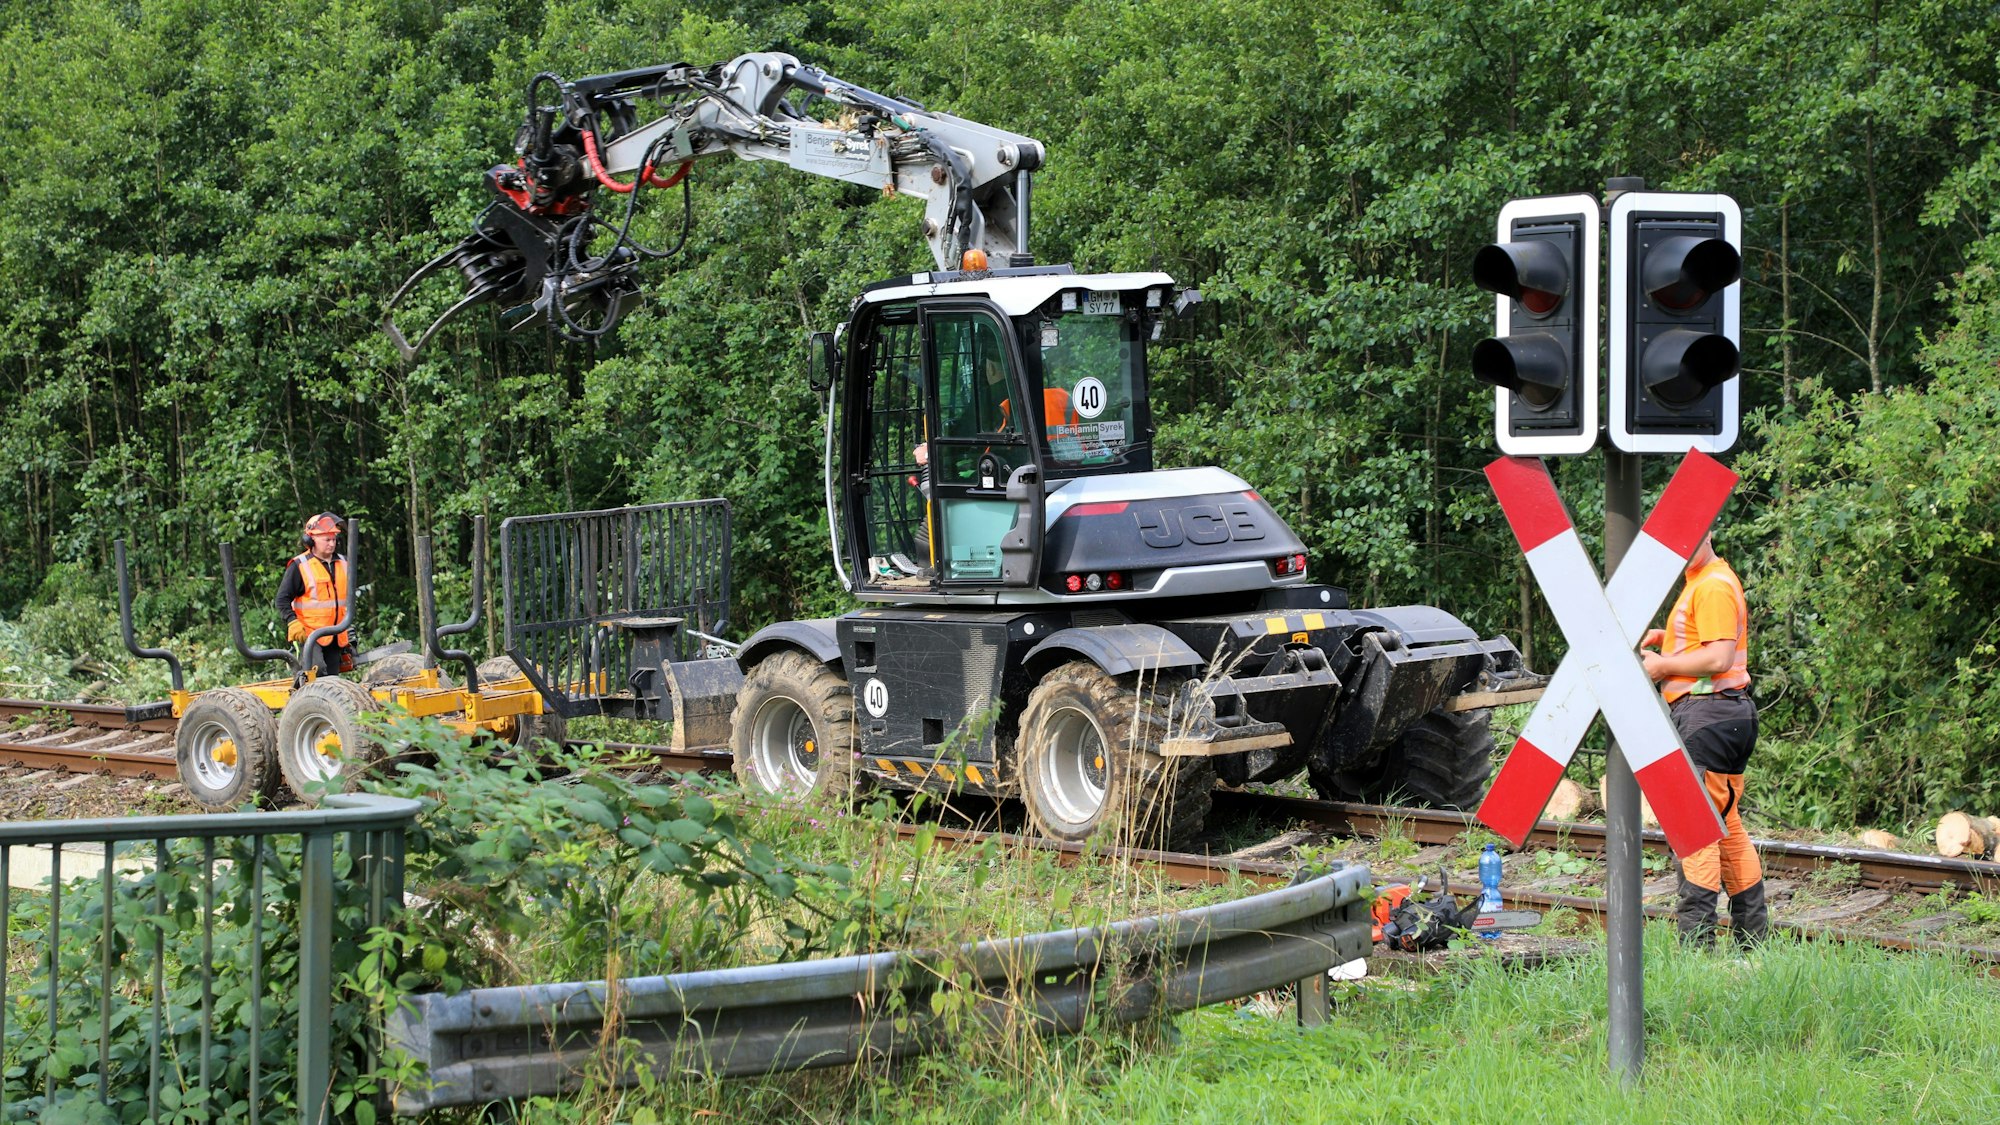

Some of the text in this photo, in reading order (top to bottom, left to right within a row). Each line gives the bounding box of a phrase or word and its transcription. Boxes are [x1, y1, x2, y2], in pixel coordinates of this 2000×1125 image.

[807, 134, 870, 152] Benja Syrek
[1090, 291, 1103, 302] GM
[1089, 302, 1114, 313] SY 77
[1081, 385, 1099, 410] 40
[1058, 422, 1124, 435] Benjamin Syrek
[1133, 502, 1266, 549] JCB
[870, 685, 883, 709] 40
